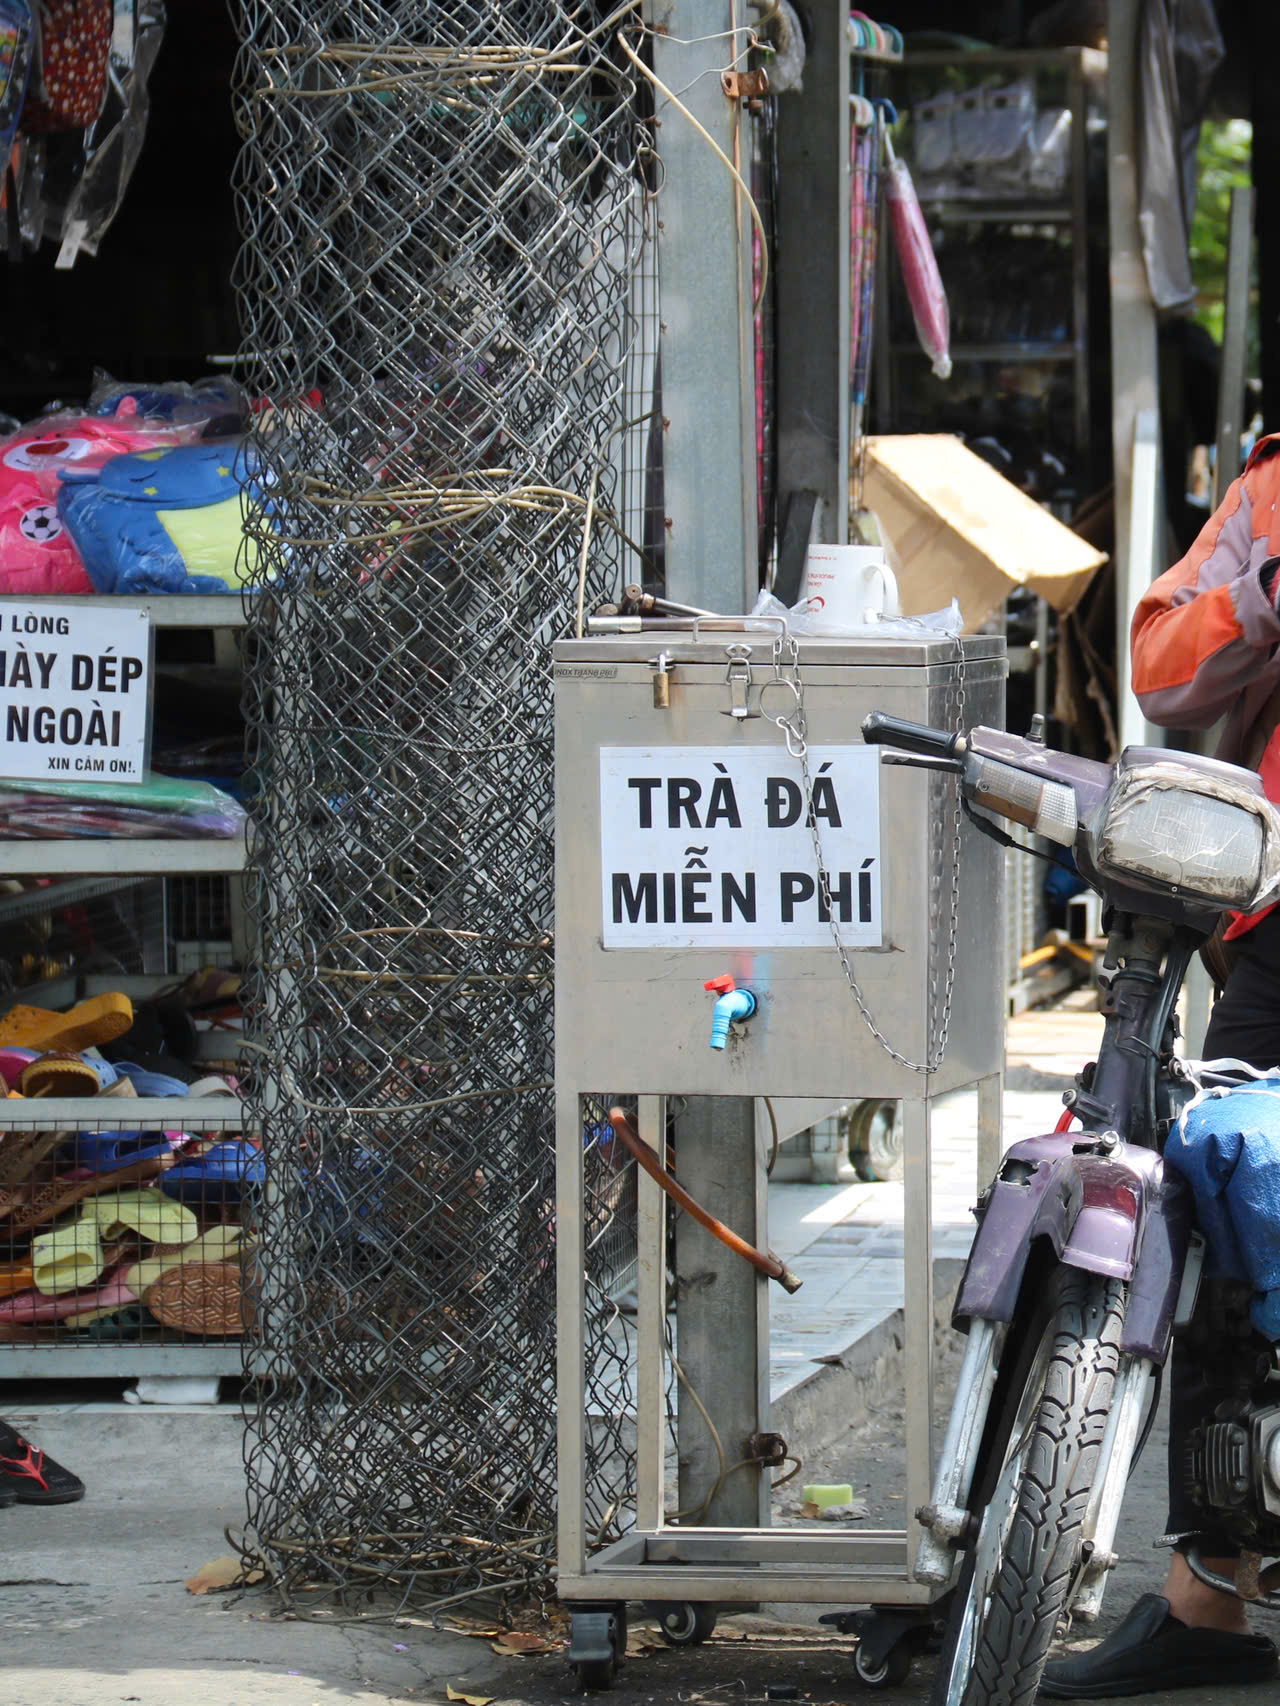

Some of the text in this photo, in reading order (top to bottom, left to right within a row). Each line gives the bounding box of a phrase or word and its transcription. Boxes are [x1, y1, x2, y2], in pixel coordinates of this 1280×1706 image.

[12, 611, 69, 636] LÒNG
[71, 646, 143, 693] DÉP
[6, 699, 121, 747] NGOÀI
[48, 757, 70, 770] XIN
[627, 762, 842, 829] TRÀ ĐÁ
[611, 845, 876, 923] MIỄN PHÍ
